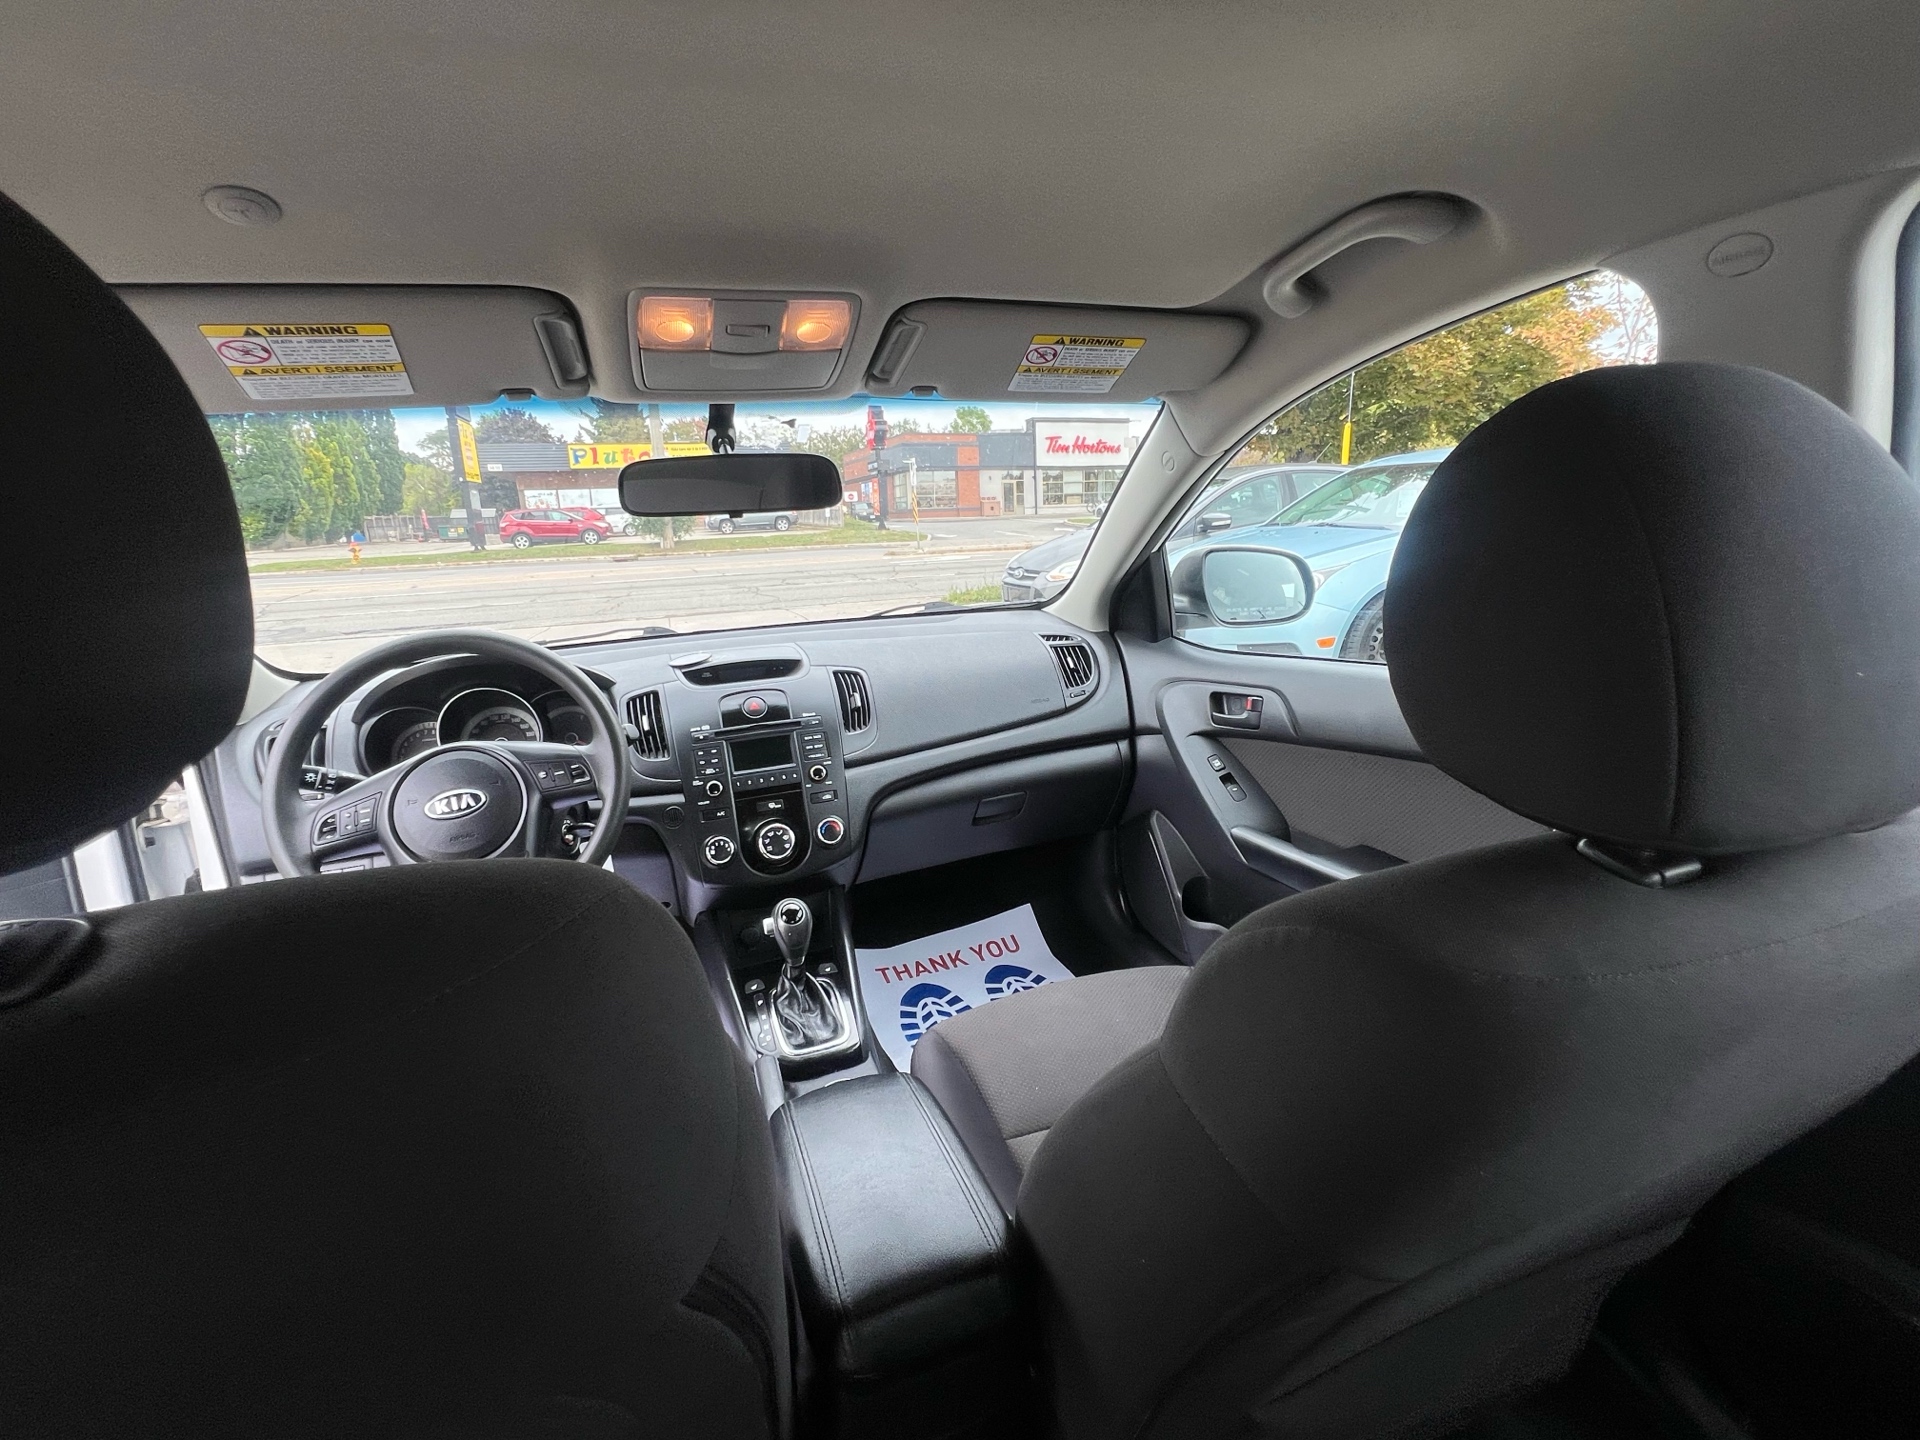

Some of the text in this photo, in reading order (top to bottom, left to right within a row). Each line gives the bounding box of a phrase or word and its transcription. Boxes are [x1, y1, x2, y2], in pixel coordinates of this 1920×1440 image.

[263, 326, 359, 336] WARNING
[1069, 337, 1125, 347] WARNING
[1045, 435, 1122, 454] Tim Hortons
[434, 793, 477, 815] KIA
[875, 934, 1021, 984] THANK YOU
